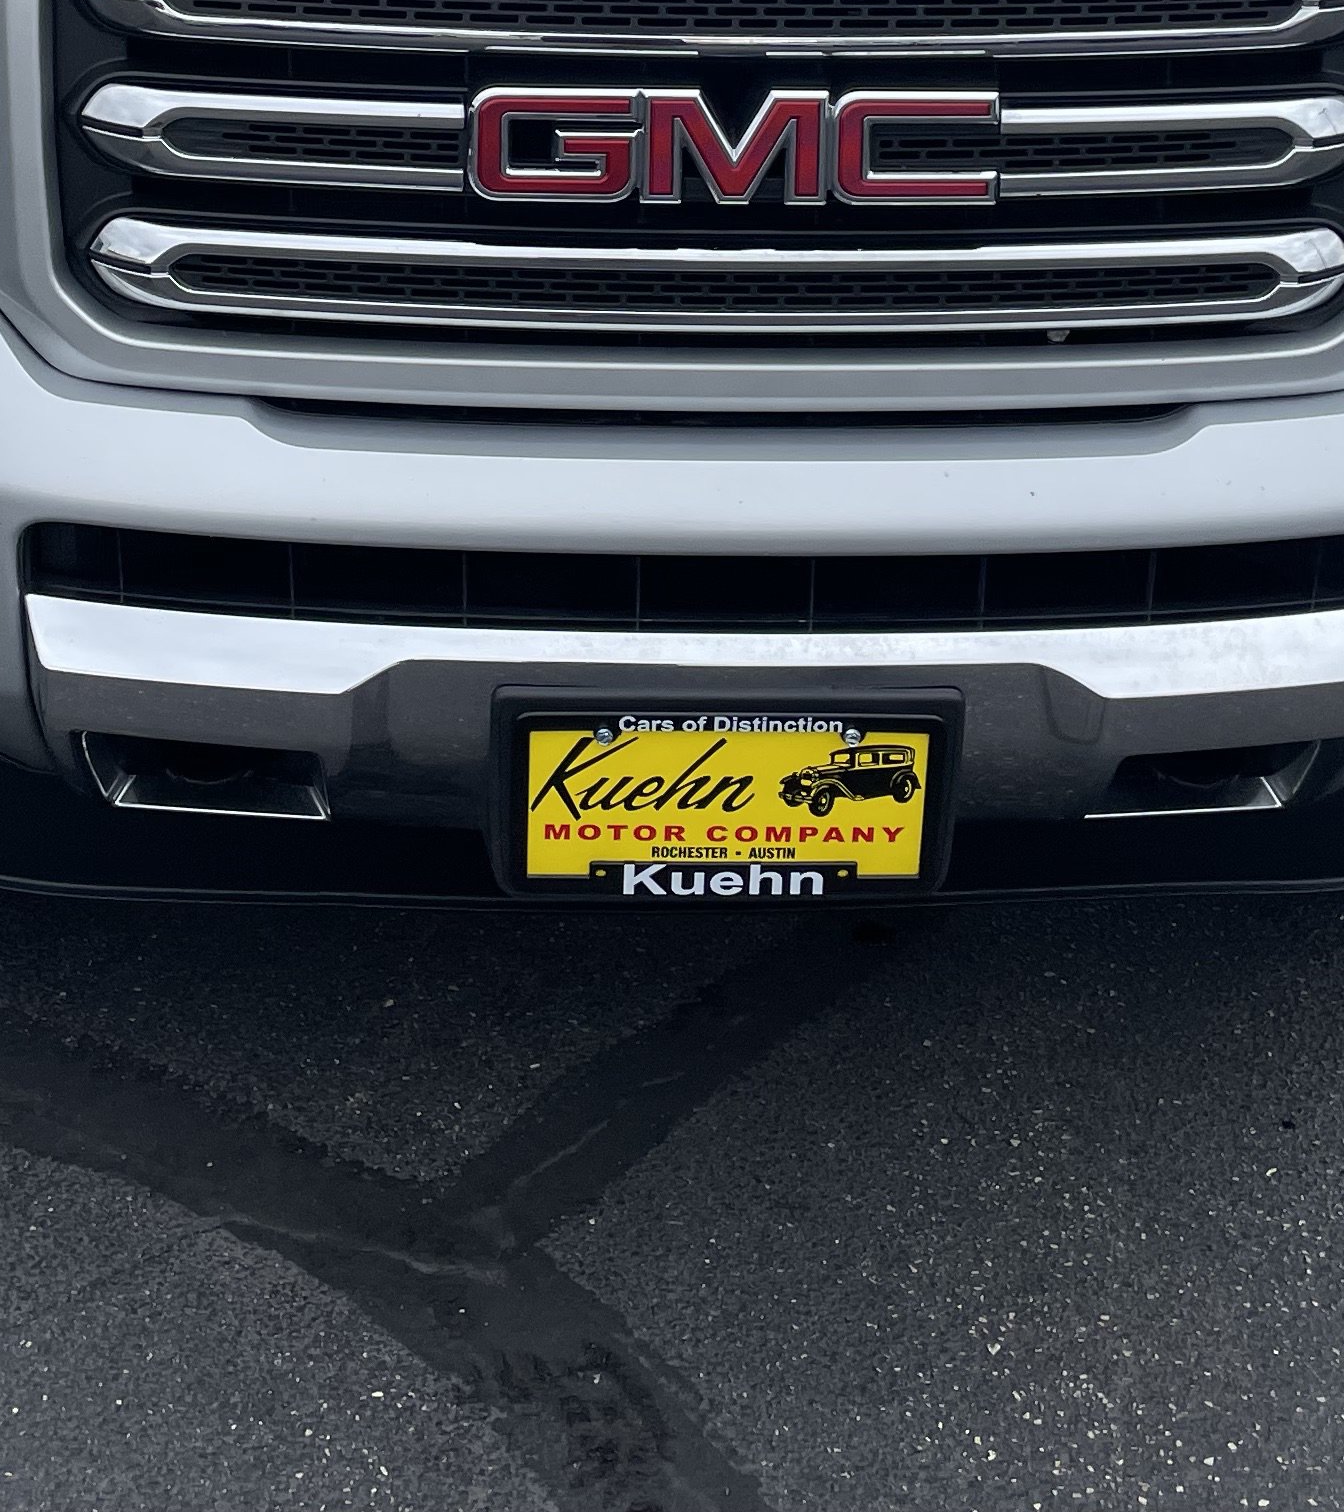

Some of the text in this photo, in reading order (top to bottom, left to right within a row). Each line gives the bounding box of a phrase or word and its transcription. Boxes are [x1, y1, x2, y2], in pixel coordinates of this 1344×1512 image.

[469, 87, 999, 205] GMC
[618, 715, 843, 733] Cars of Distinction
[530, 736, 755, 821] Kuehn
[543, 823, 906, 843] MOTOR COMPANY
[651, 846, 796, 859] ROCHESTER AUSTIN
[622, 863, 824, 896] Kuehn
